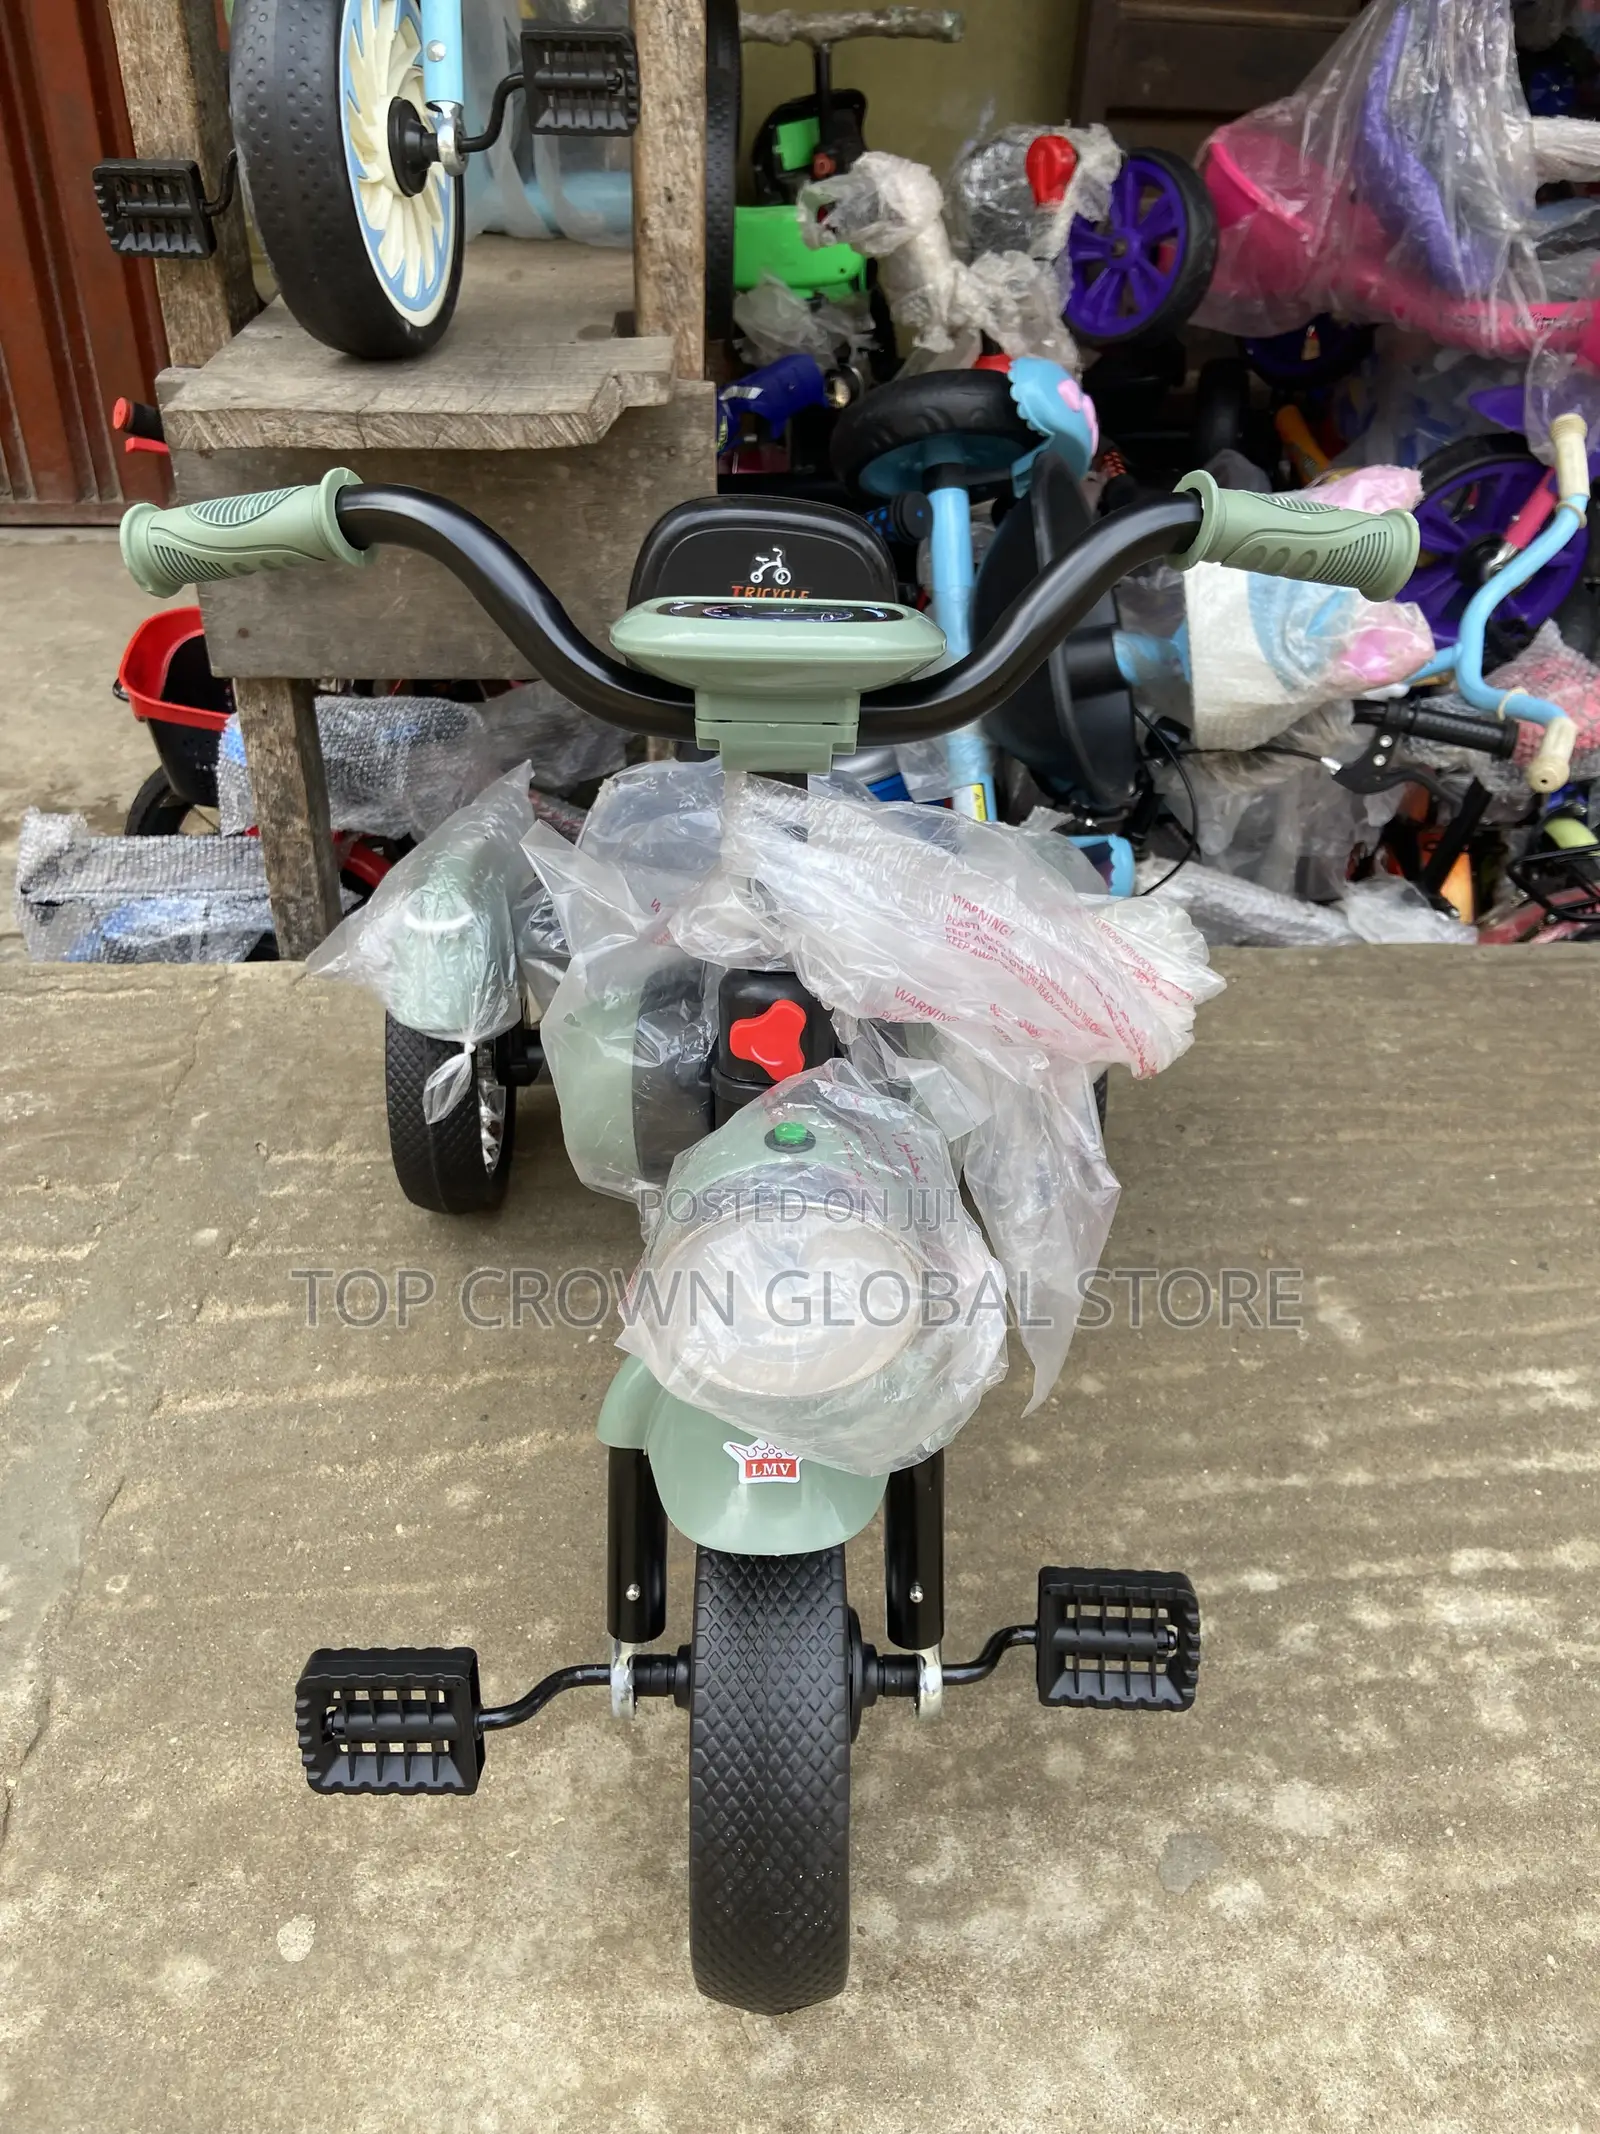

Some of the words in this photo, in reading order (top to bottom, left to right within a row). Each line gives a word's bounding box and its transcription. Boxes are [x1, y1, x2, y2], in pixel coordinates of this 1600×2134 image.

[945, 914, 980, 931] PLASTI
[946, 934, 970, 950] KEEP
[751, 1462, 791, 1477] LMV
